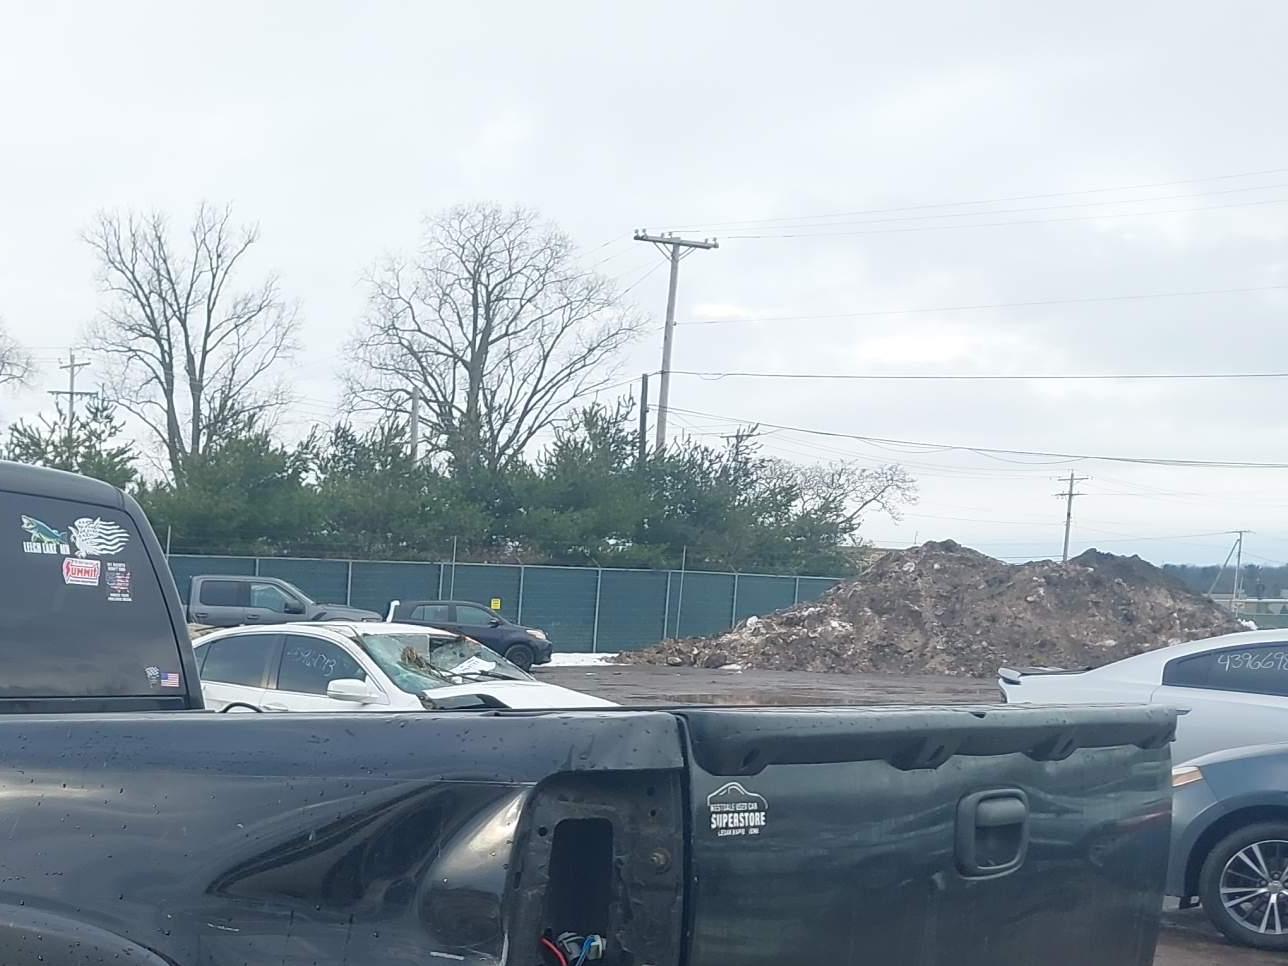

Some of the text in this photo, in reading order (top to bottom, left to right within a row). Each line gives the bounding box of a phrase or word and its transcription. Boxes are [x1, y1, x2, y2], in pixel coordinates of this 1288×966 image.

[42, 542, 58, 555] LAKE
[65, 561, 98, 578] SUMMIT
[710, 812, 766, 829] SUPERSTORE
